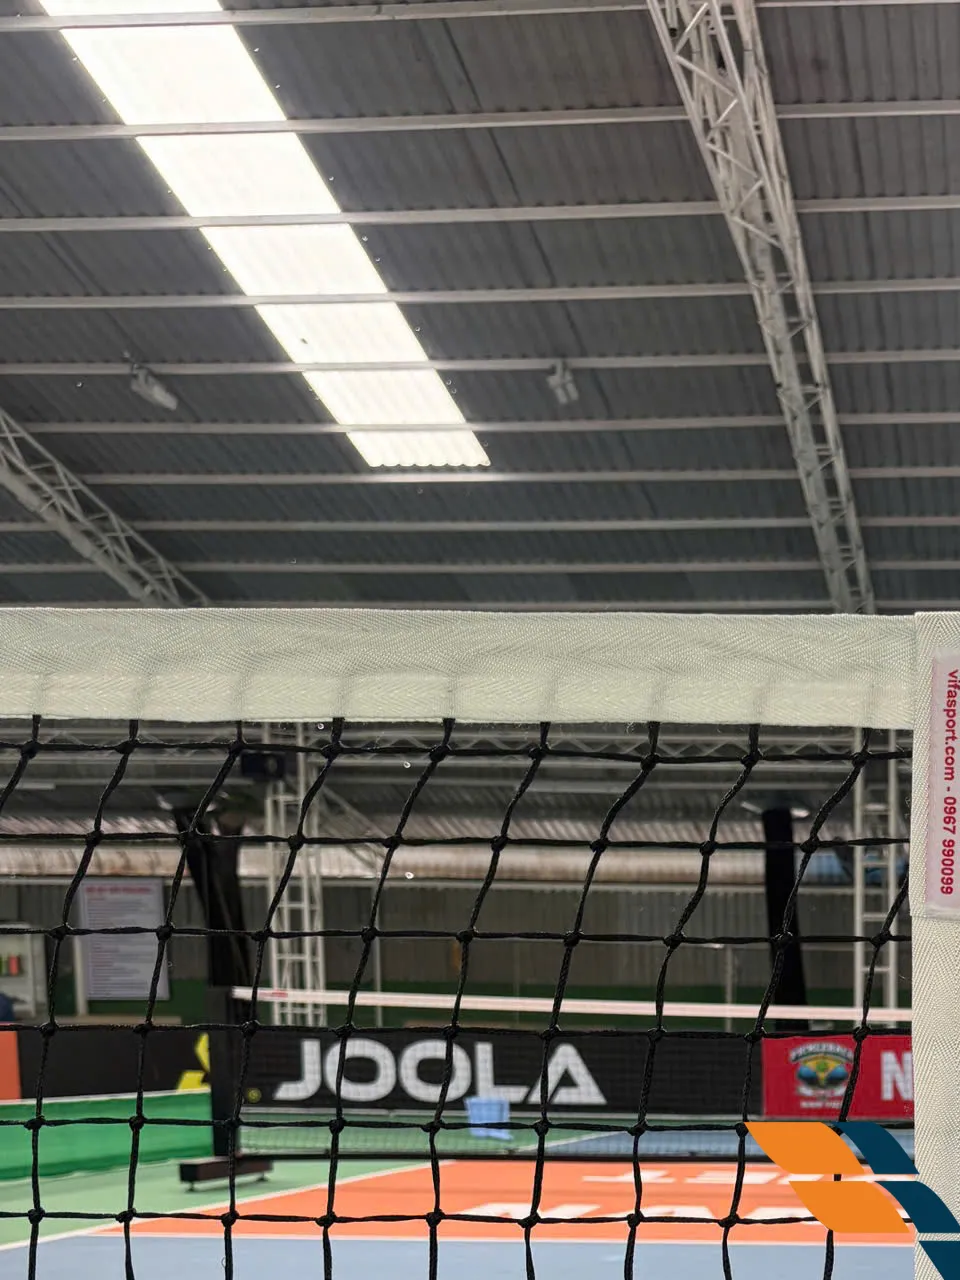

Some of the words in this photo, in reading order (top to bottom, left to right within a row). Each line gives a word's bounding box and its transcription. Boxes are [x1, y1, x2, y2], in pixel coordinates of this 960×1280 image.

[941, 669, 960, 781] vifasport.com
[942, 796, 958, 836] 0967
[940, 839, 956, 896] 990099
[273, 1039, 607, 1105] JOOLA
